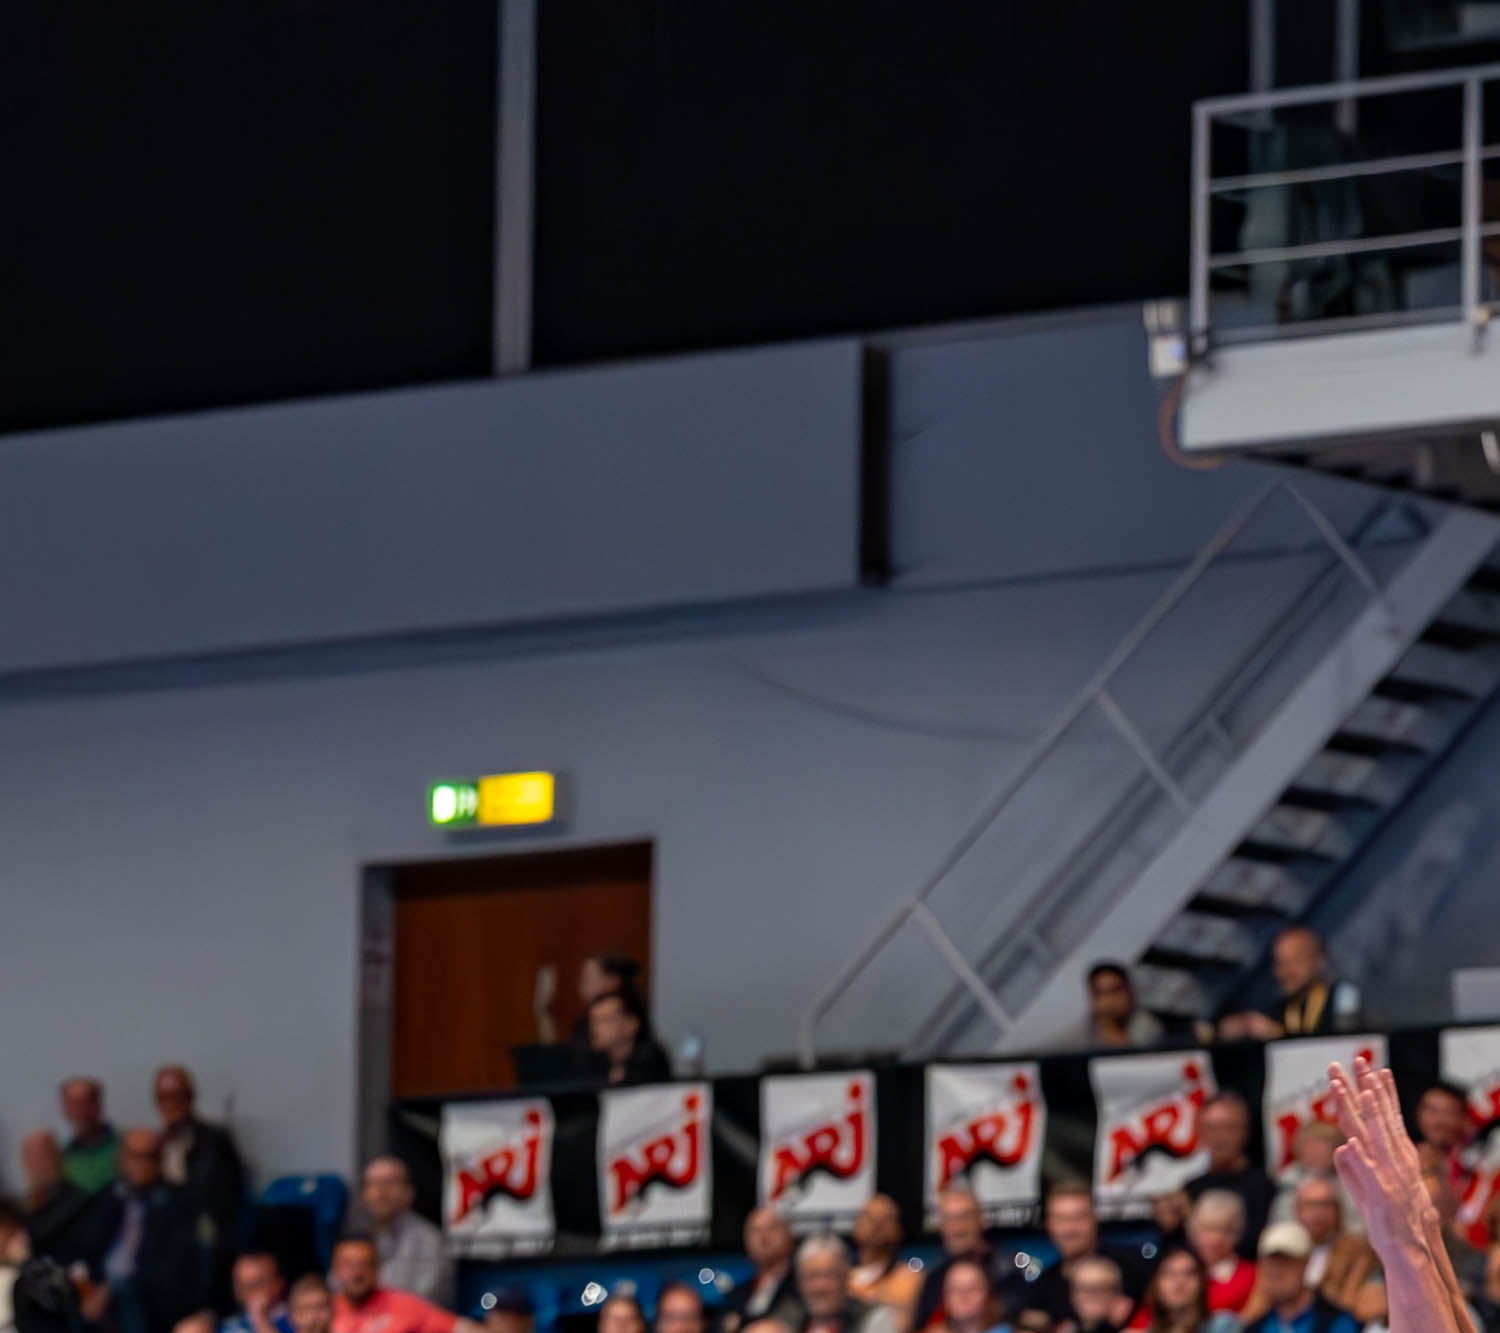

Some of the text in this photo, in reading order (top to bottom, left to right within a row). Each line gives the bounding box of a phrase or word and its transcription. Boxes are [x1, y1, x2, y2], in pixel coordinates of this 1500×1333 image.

[449, 1110, 543, 1225] NRJ
[609, 1092, 700, 1216] NRJ
[770, 1081, 864, 1202] NRJ
[937, 1073, 1035, 1193] NRJ
